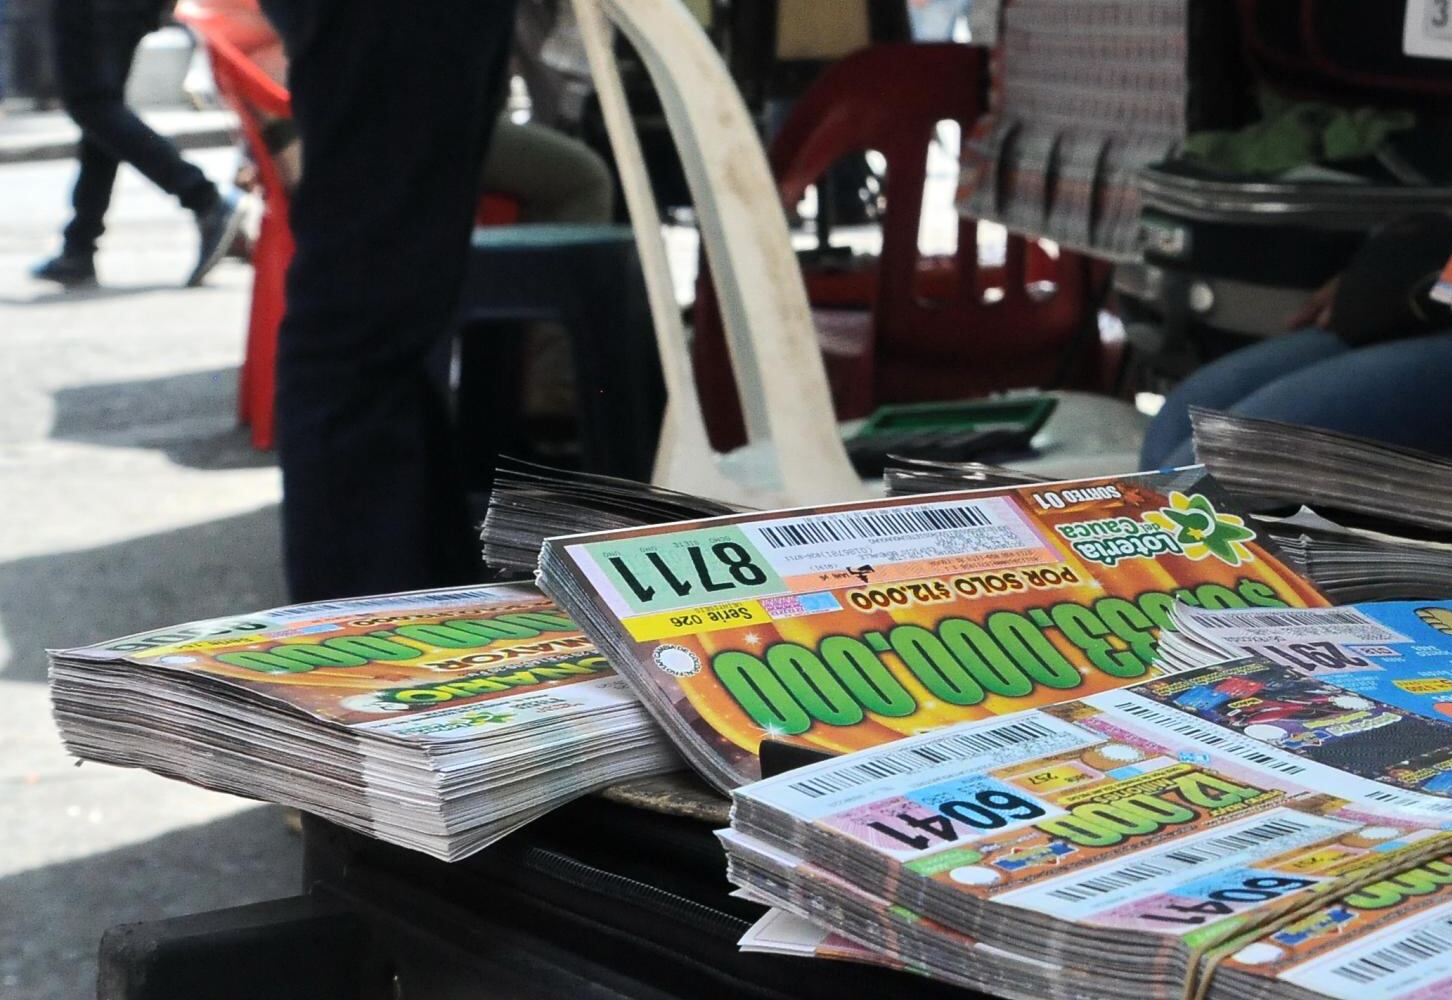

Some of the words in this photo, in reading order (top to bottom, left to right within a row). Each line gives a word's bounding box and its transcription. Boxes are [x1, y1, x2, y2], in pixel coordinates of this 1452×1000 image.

[1032, 493, 1060, 511] 01
[1063, 484, 1121, 502] SORTEO
[1058, 517, 1140, 540] Cauca
[610, 541, 768, 602] 8711
[1024, 567, 1079, 590] POR
[851, 580, 952, 609] $12.000
[957, 571, 1018, 599] SOLO
[670, 613, 703, 628] 026
[710, 606, 753, 626] Serie
[866, 789, 1048, 851] 6041
